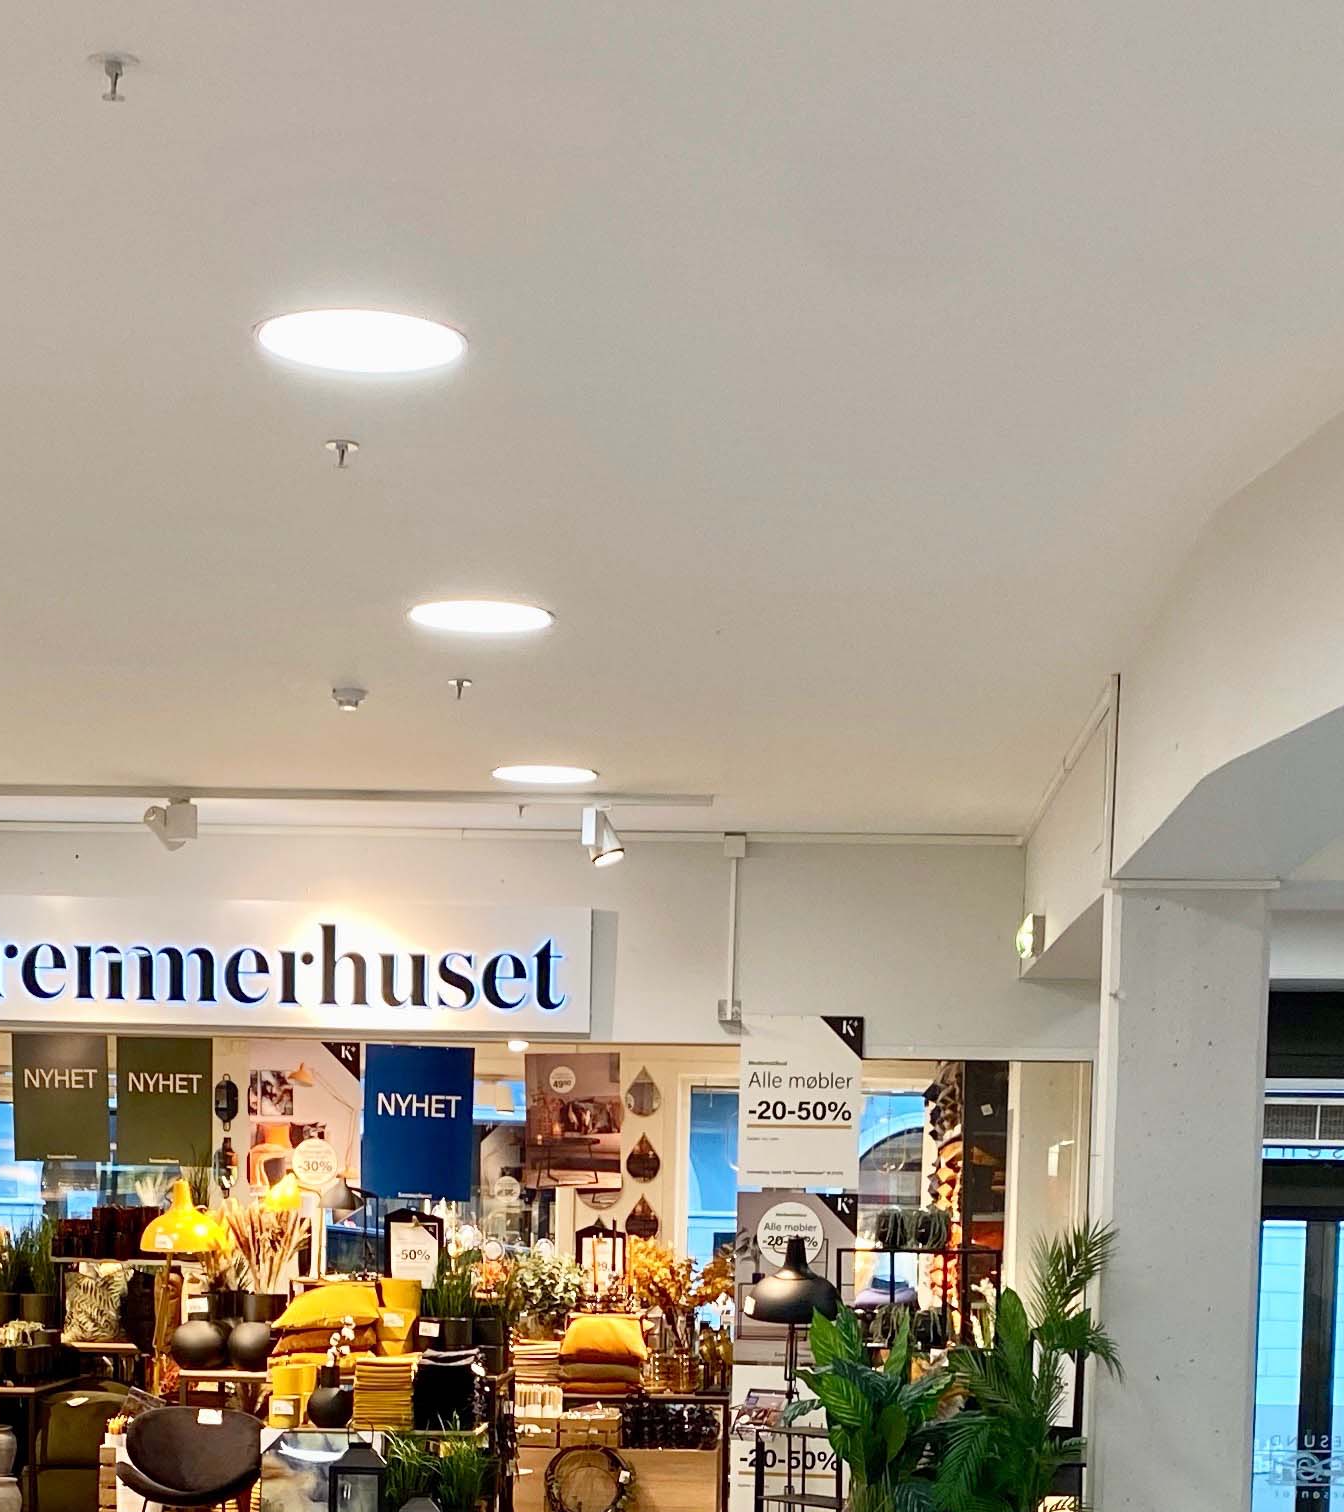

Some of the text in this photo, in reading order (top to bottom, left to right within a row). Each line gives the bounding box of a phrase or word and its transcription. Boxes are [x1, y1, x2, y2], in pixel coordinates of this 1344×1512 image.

[24, 1068, 98, 1089] NYHET
[128, 1071, 203, 1094] NYHET
[748, 1071, 853, 1089] Alle møbler
[377, 1092, 462, 1118] NYHET
[748, 1100, 852, 1121] -20-50%
[298, 1159, 333, 1172] -30%
[763, 1222, 782, 1232] Alle
[762, 1235, 819, 1247] -20-%
